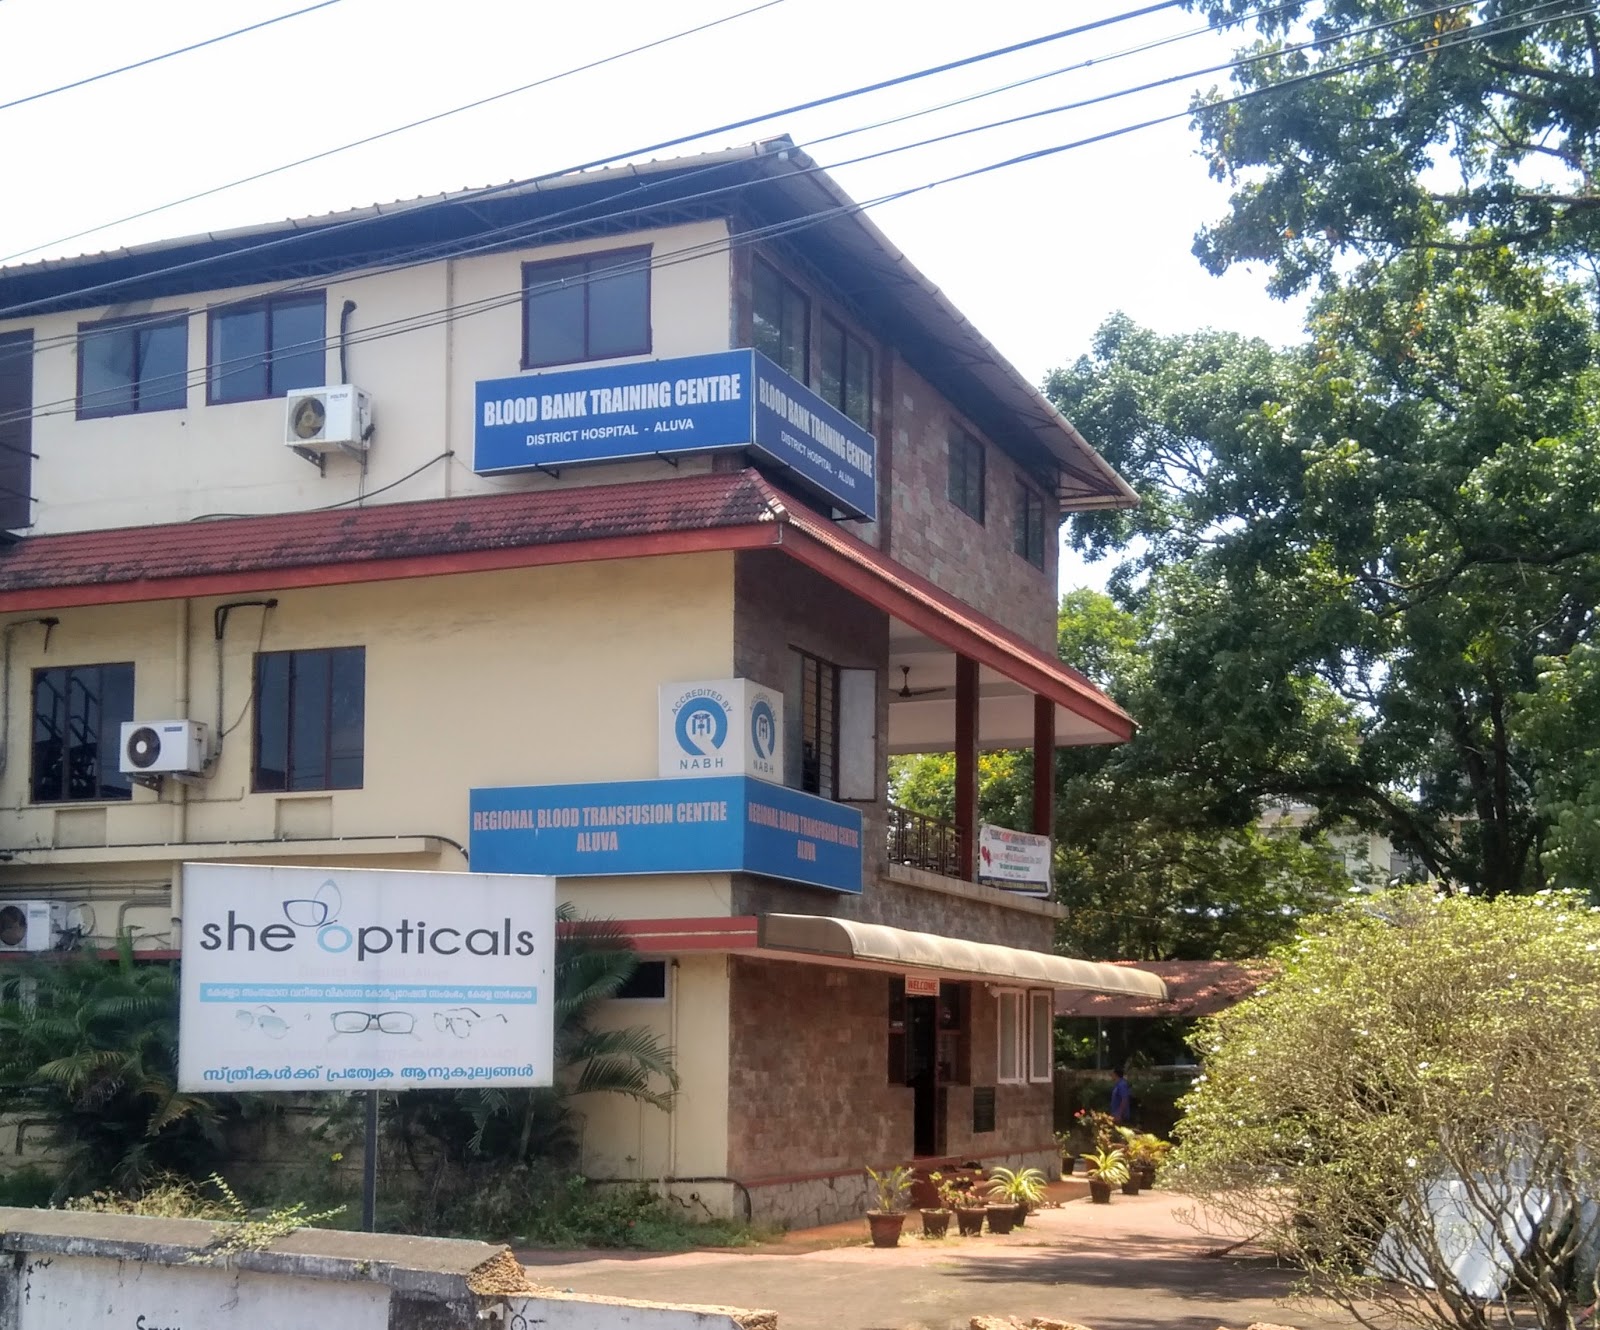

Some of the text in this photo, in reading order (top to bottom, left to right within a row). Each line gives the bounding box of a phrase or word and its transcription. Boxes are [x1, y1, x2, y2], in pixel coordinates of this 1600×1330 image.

[484, 373, 741, 427] BLOOD BANK TRAINING CENTRE
[526, 430, 578, 446] DISTRICT
[581, 424, 638, 440] HOSPITAL
[654, 418, 694, 433] ALUVA
[760, 377, 873, 478] BLOOD BANK TRAINING CENTRE
[781, 430, 806, 455] DISTRICT
[807, 448, 833, 474] HOSPITAL
[838, 470, 855, 488] ALUVA
[672, 688, 733, 715] ACCREDITED BY
[680, 758, 723, 770] NABH
[753, 760, 774, 774] NABH
[474, 801, 727, 831] REGIONAL BLOOD TRANSFUSION CENTRE
[577, 831, 618, 852] ALUVA
[200, 910, 535, 962] she opticals
[908, 980, 937, 991] WELCOME
[326, 1067, 394, 1082] പ്രത്യേക
